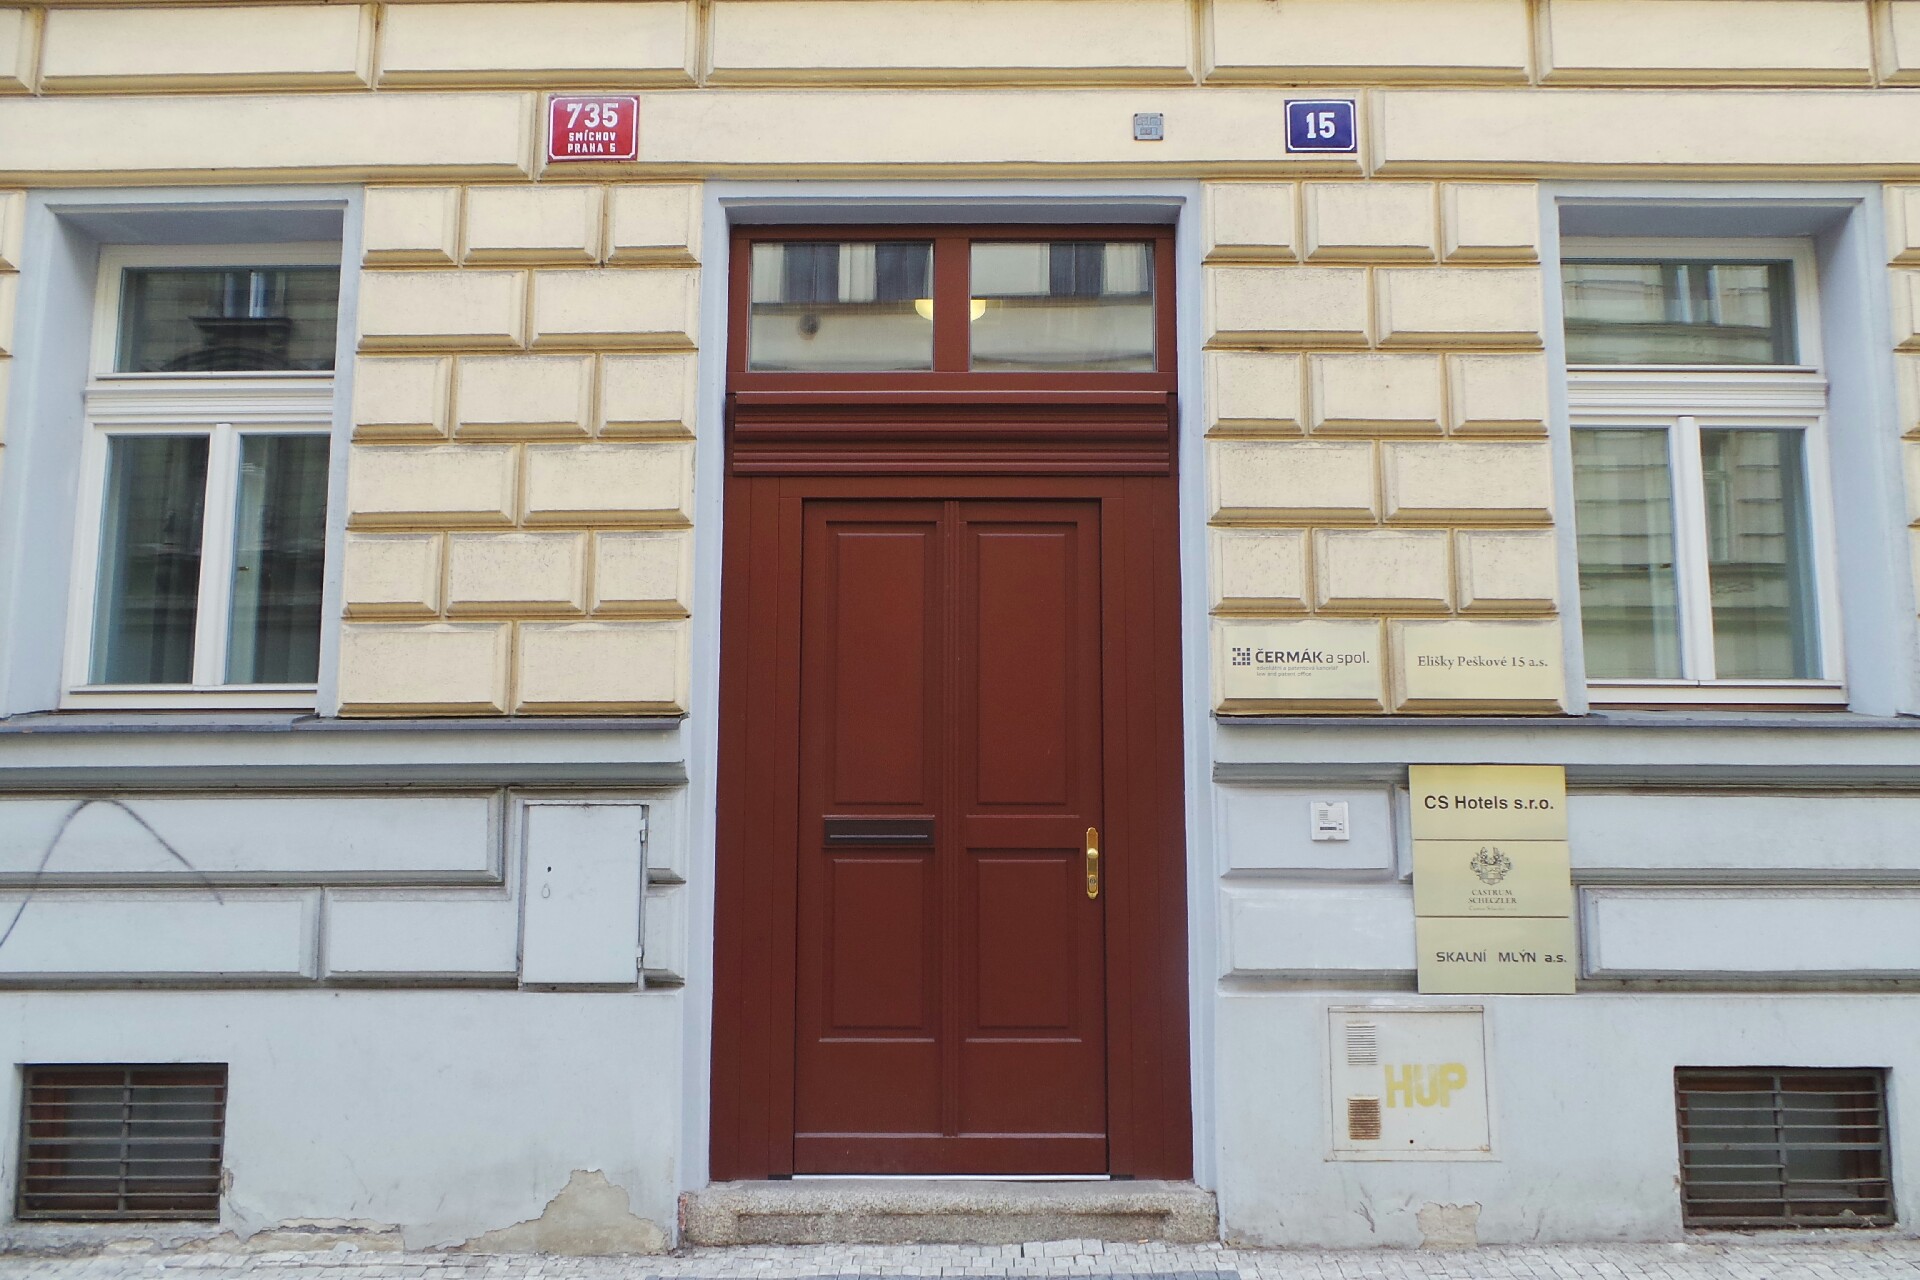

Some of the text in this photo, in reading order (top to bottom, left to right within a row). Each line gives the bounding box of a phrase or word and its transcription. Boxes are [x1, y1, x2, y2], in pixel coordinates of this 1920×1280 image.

[566, 103, 618, 128] 735
[1306, 112, 1336, 139] 15
[569, 129, 616, 141] SMÍCHOV
[567, 143, 604, 153] PRAHA
[1255, 648, 1370, 666] ČERMÁK a spol.
[1417, 655, 1548, 670] Elišky Peškové 15 a.s.
[1424, 795, 1554, 810] CS Hotels s.r.o.
[1436, 949, 1567, 963] SKALNÍ MLÝN a.s.
[1384, 1062, 1468, 1108] HUP
